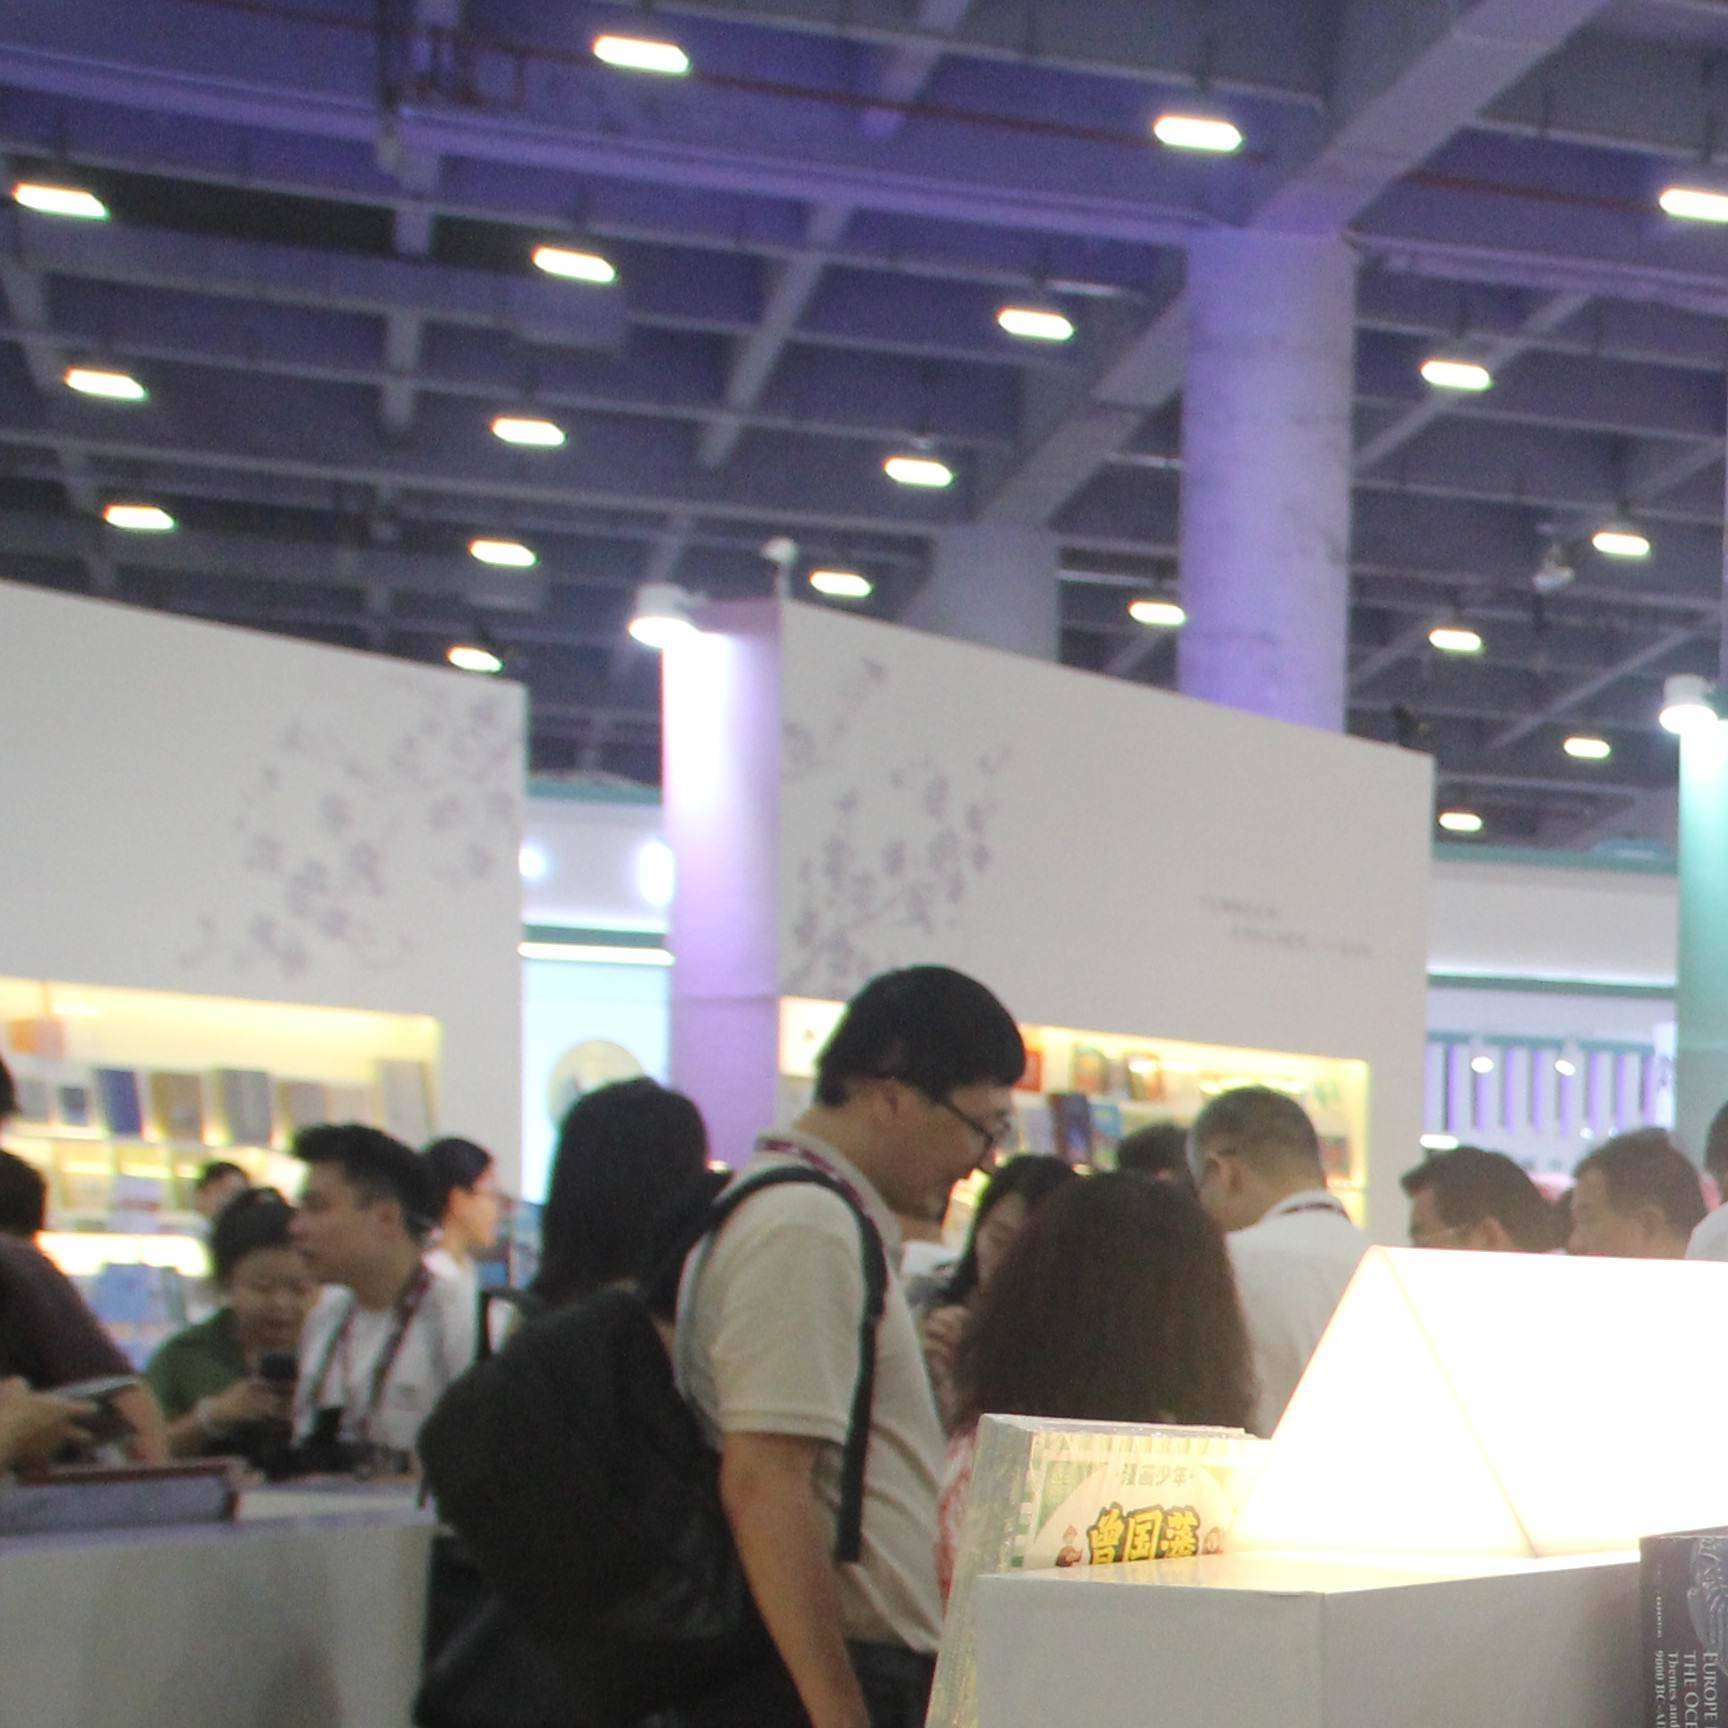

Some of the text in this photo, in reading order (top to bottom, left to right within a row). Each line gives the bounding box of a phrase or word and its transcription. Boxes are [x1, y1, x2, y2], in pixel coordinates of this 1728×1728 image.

[1087, 1500, 1206, 1566] 曾国藩
[1683, 1650, 1700, 1687] THE
[1702, 1651, 1721, 1721] EUROPE
